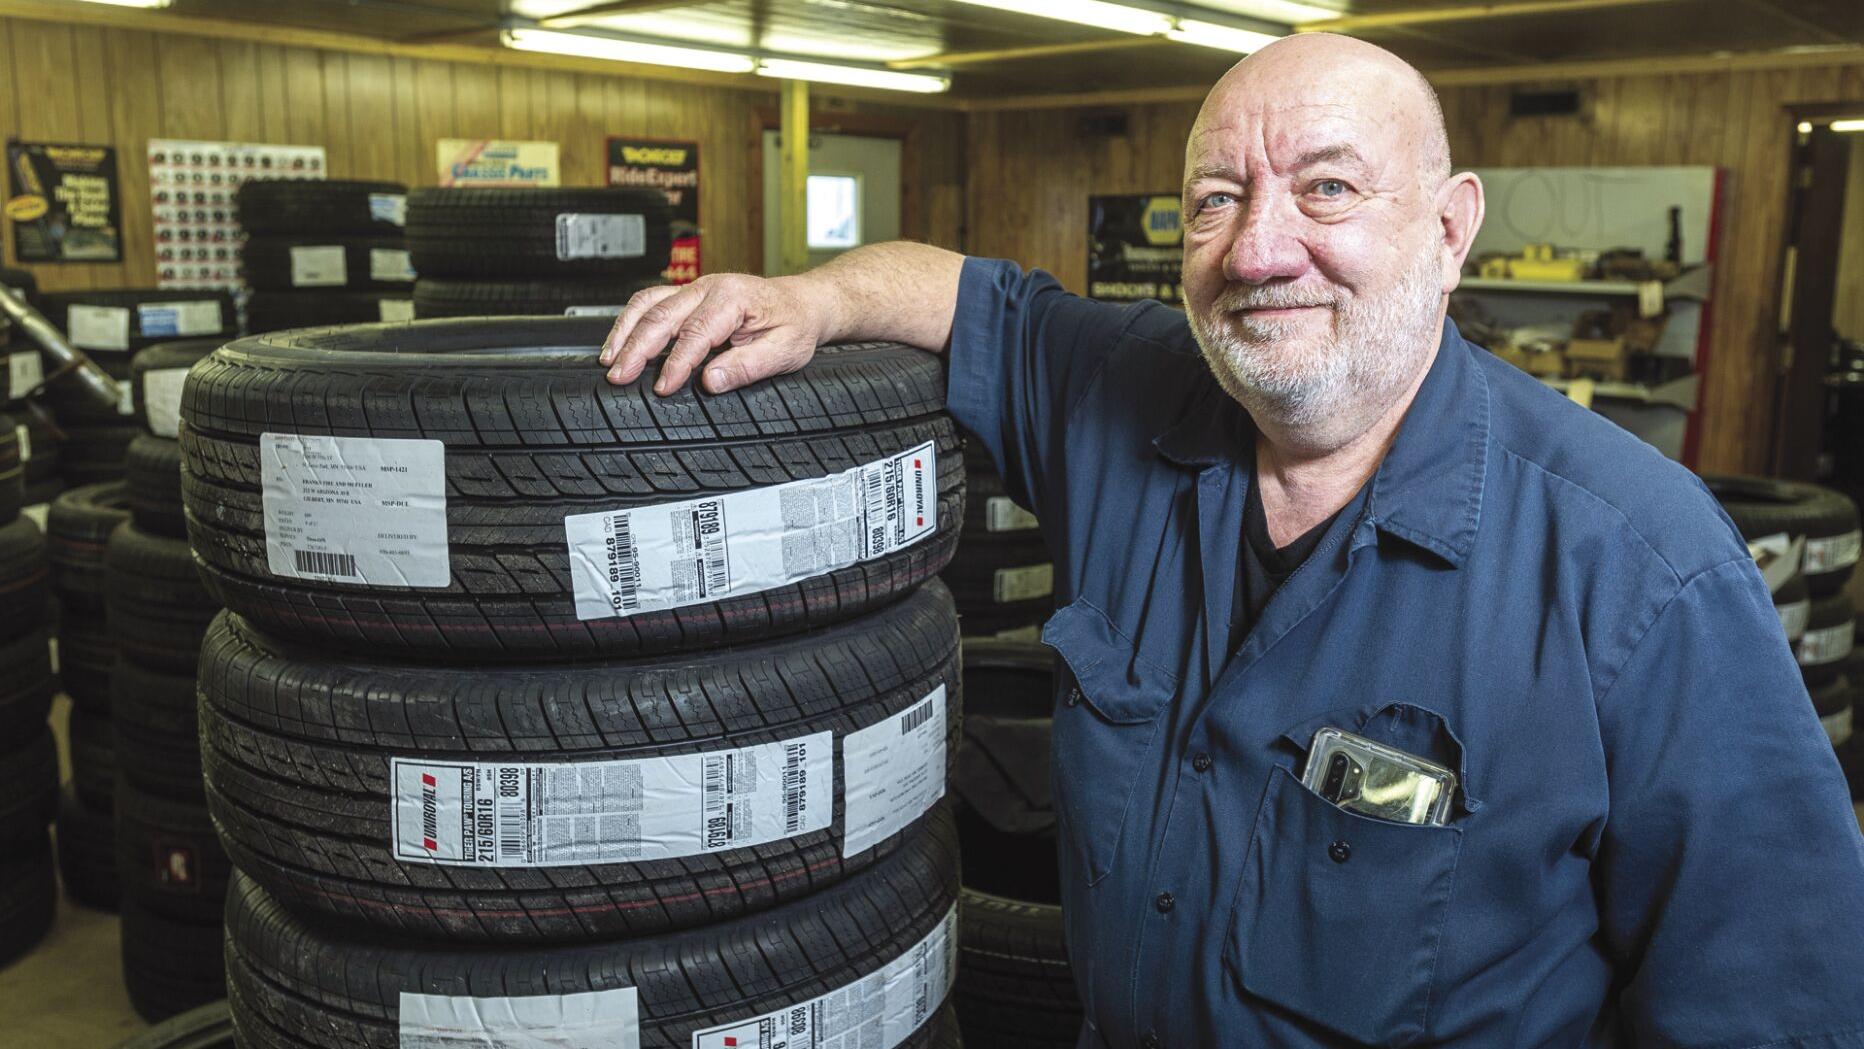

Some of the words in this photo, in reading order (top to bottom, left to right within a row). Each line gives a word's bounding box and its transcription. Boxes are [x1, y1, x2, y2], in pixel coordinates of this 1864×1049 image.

[884, 460, 896, 521] 215/60R16
[915, 470, 924, 515] UNIROYAL
[699, 501, 720, 535] 879189
[872, 526, 884, 555] 80398
[632, 547, 642, 588] 95-90011
[463, 768, 472, 781] A/S
[500, 768, 519, 797] 80398
[464, 783, 473, 812] TOURING
[423, 788, 437, 839] UNIROYAL
[464, 817, 473, 835] PAW
[478, 799, 494, 862] 215/60R16
[707, 817, 726, 848] 879189
[464, 838, 474, 860] TIGER
[791, 1006, 807, 1036] 80398
